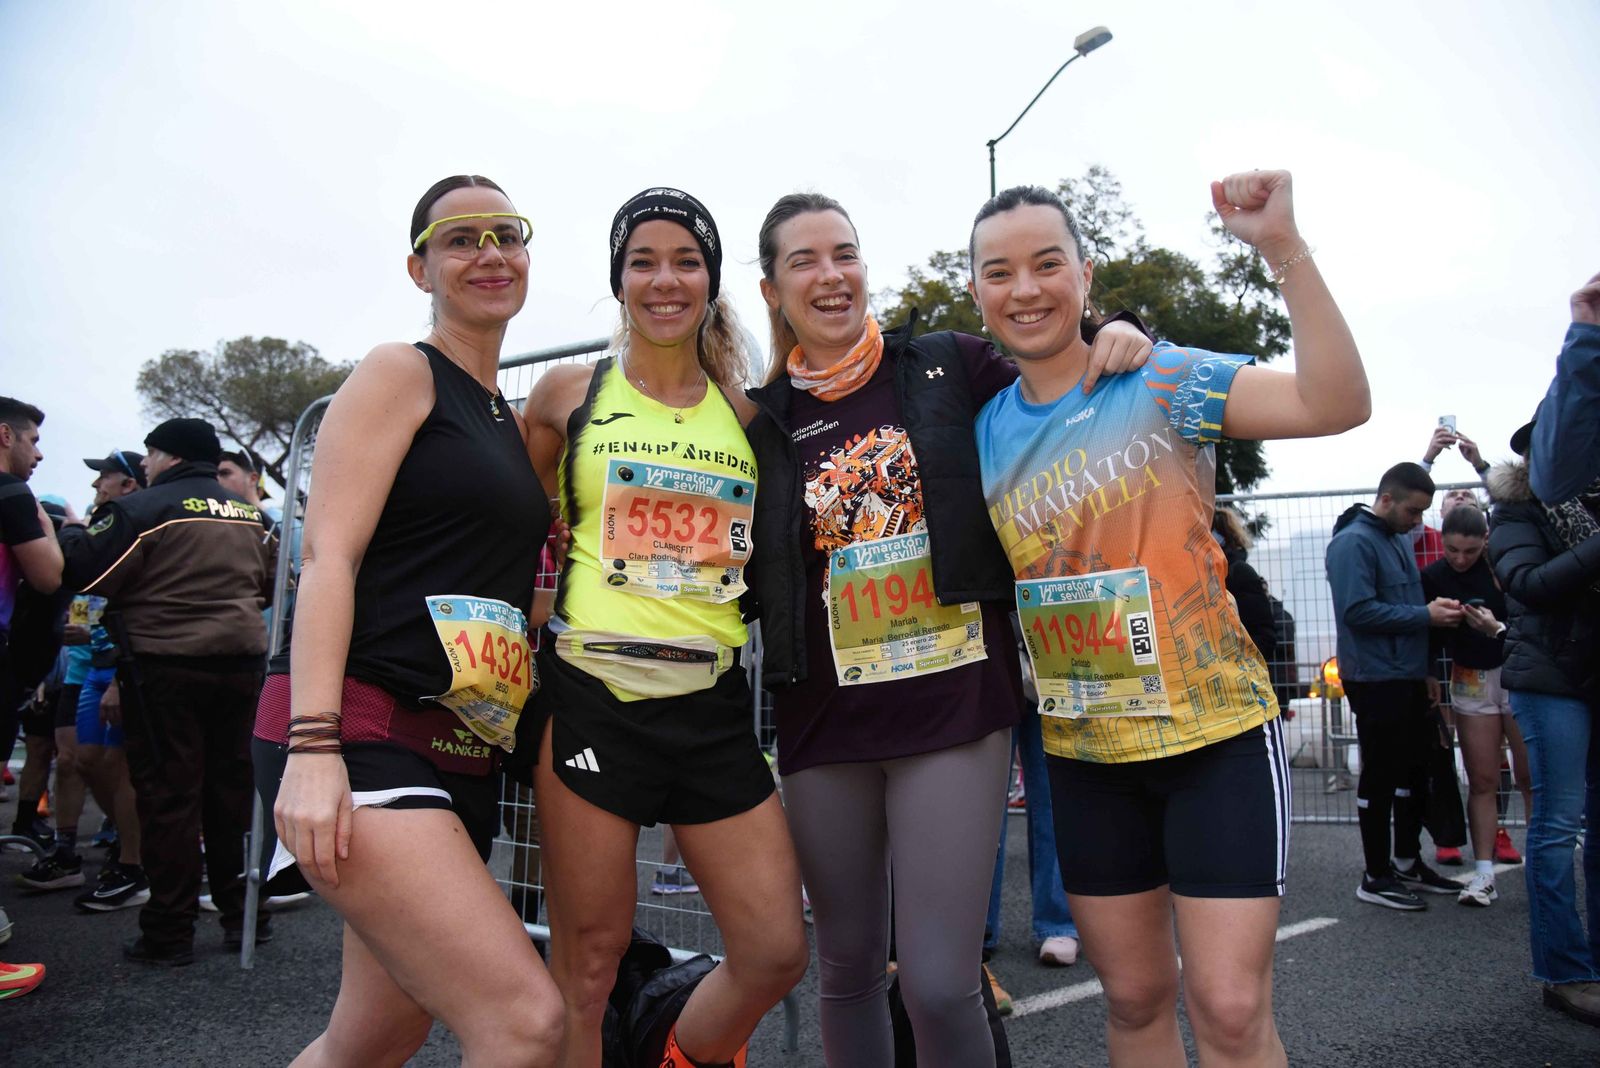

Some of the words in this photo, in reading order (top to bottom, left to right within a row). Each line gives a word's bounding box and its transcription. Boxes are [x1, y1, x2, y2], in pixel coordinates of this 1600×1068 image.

[662, 206, 688, 216] Training
[1065, 406, 1096, 427] HOKA
[790, 420, 824, 438] ationale
[794, 421, 840, 443] derlanden
[662, 469, 714, 485] maratón
[996, 448, 1087, 523] MEDIO
[1014, 427, 1174, 538] MARATÓN
[673, 479, 713, 495] sevilla
[1039, 465, 1162, 546] SEVILLA
[627, 497, 719, 545] 5532
[653, 541, 694, 554] CLARISFIT
[870, 536, 923, 555] maratón
[884, 545, 925, 561] sevilla
[628, 552, 649, 560] Clara
[1049, 579, 1091, 592] maratón
[841, 568, 934, 622] 1194
[1060, 588, 1094, 601] sevilla
[485, 603, 519, 621] maratón
[495, 613, 521, 630] sevilla
[890, 616, 918, 628] Mariab
[887, 629, 921, 641] Berrocal
[921, 623, 950, 635] Renedo
[909, 638, 927, 646] enero
[927, 634, 942, 642] 2026
[1032, 612, 1128, 656] 11944
[454, 630, 531, 689] 14321
[891, 662, 914, 673] HOKA
[919, 657, 945, 667] Sprinter
[1094, 672, 1125, 681] Renedo
[1096, 681, 1112, 689] 2026
[496, 681, 509, 694] BEGO
[432, 738, 491, 758] HANKER
